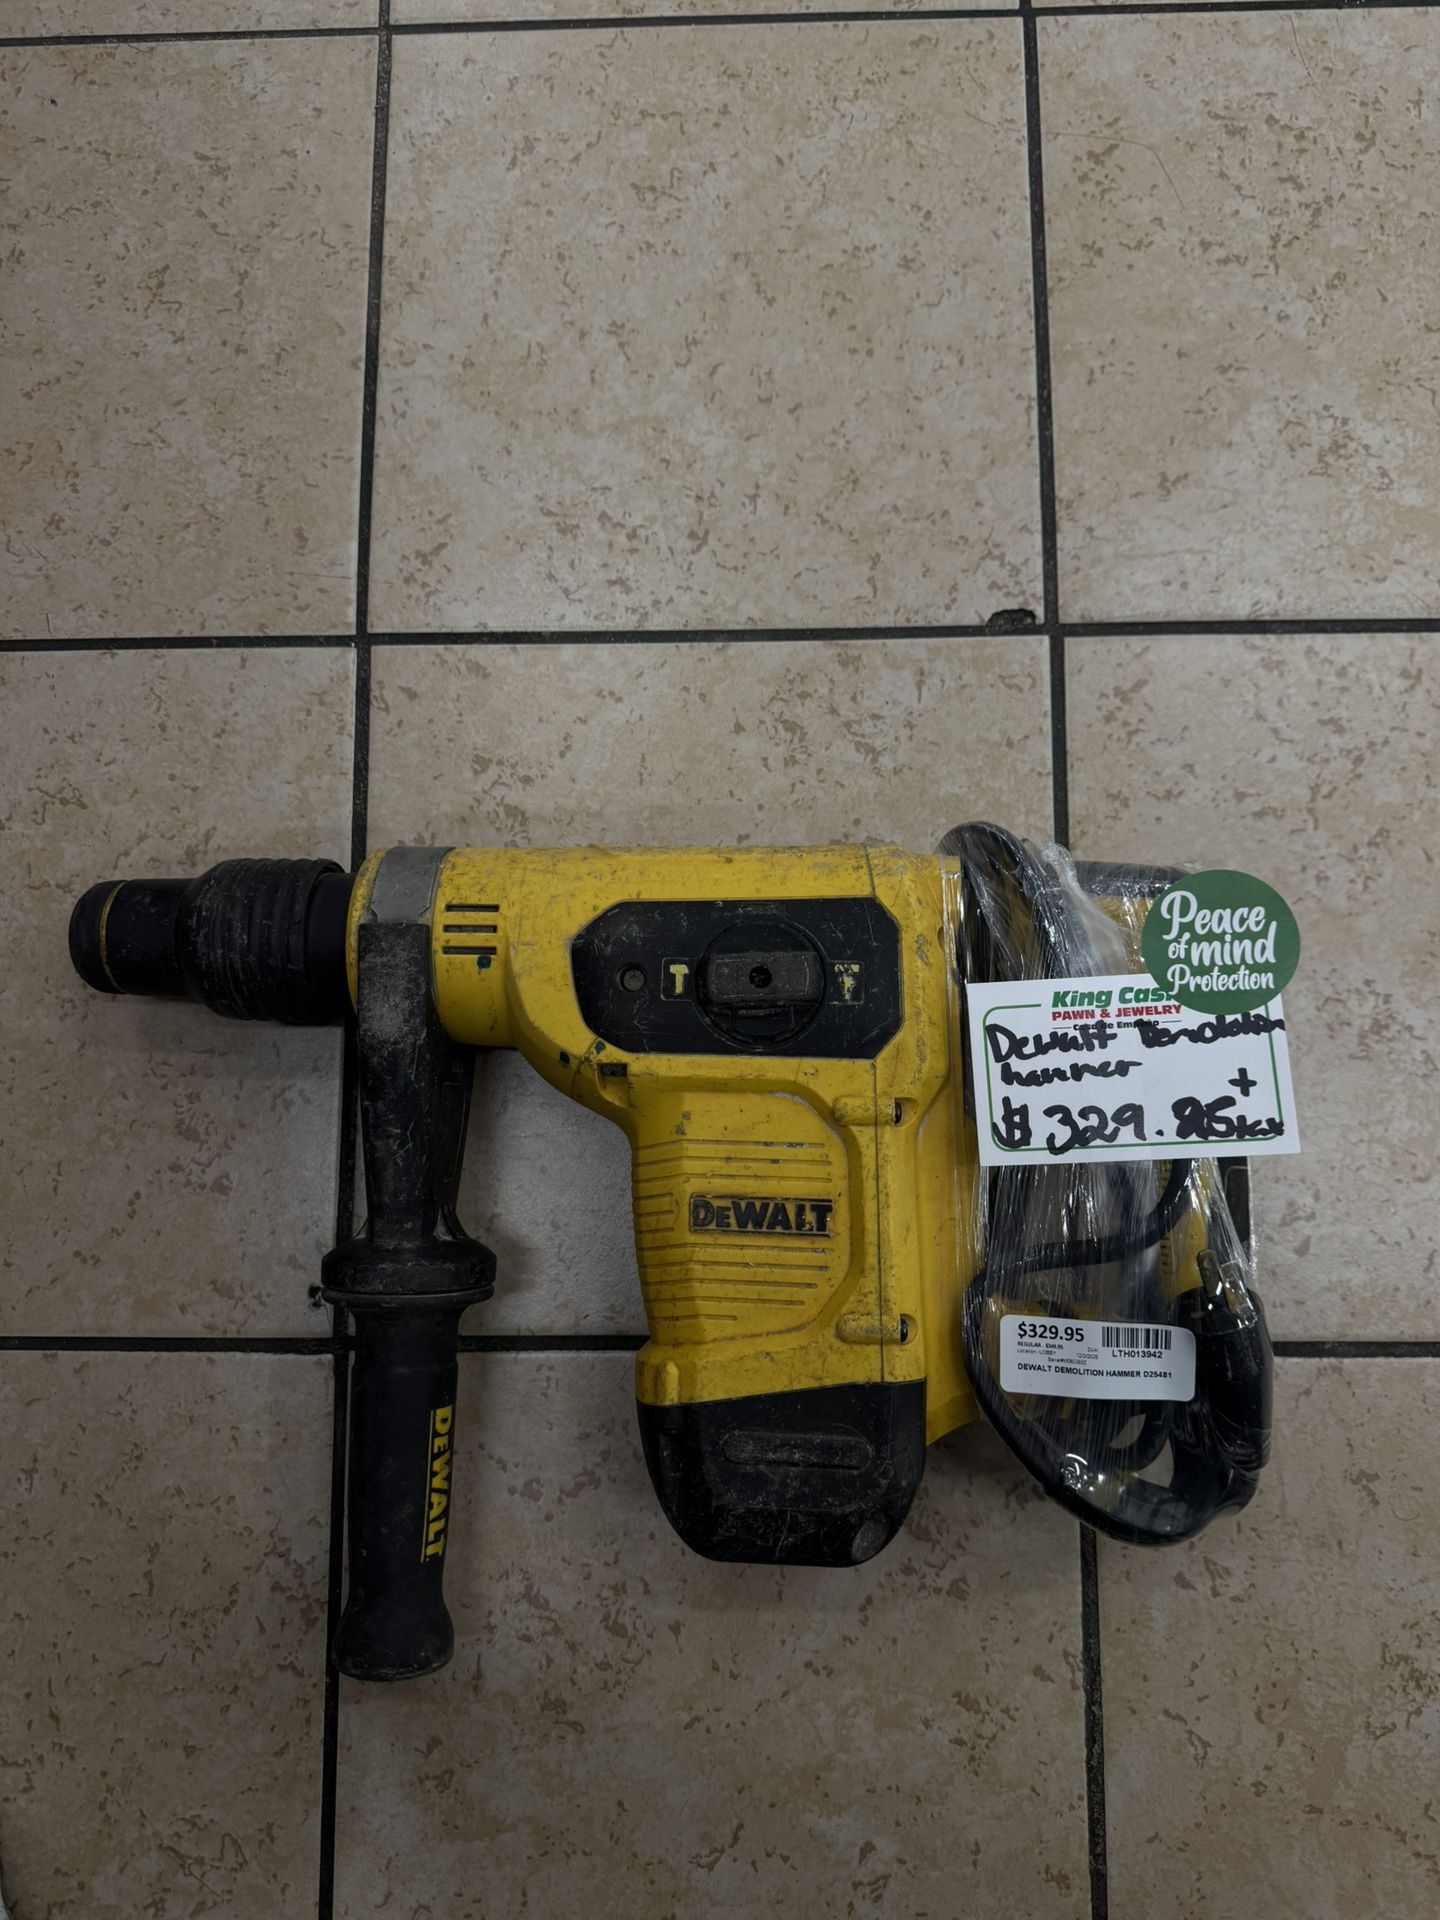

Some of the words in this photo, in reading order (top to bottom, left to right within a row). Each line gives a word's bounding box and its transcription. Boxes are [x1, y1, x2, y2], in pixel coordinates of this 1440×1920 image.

[1160, 890, 1267, 940] Peace
[1167, 931, 1191, 959] of
[1190, 920, 1278, 967] mind
[1166, 963, 1276, 995] Protection
[1051, 990, 1113, 1009] King
[1051, 1009, 1096, 1021] PAWN
[1100, 1008, 1111, 1019] &
[1115, 1004, 1182, 1018] JEWELRY
[1017, 1321, 1085, 1342] $329.95
[1112, 1350, 1164, 1359] LTH013942
[1017, 1363, 1053, 1372] DEWALT
[1054, 1366, 1105, 1377] DEMOLITION
[1106, 1369, 1142, 1378] HAMMER
[1143, 1371, 1173, 1379] D25481
